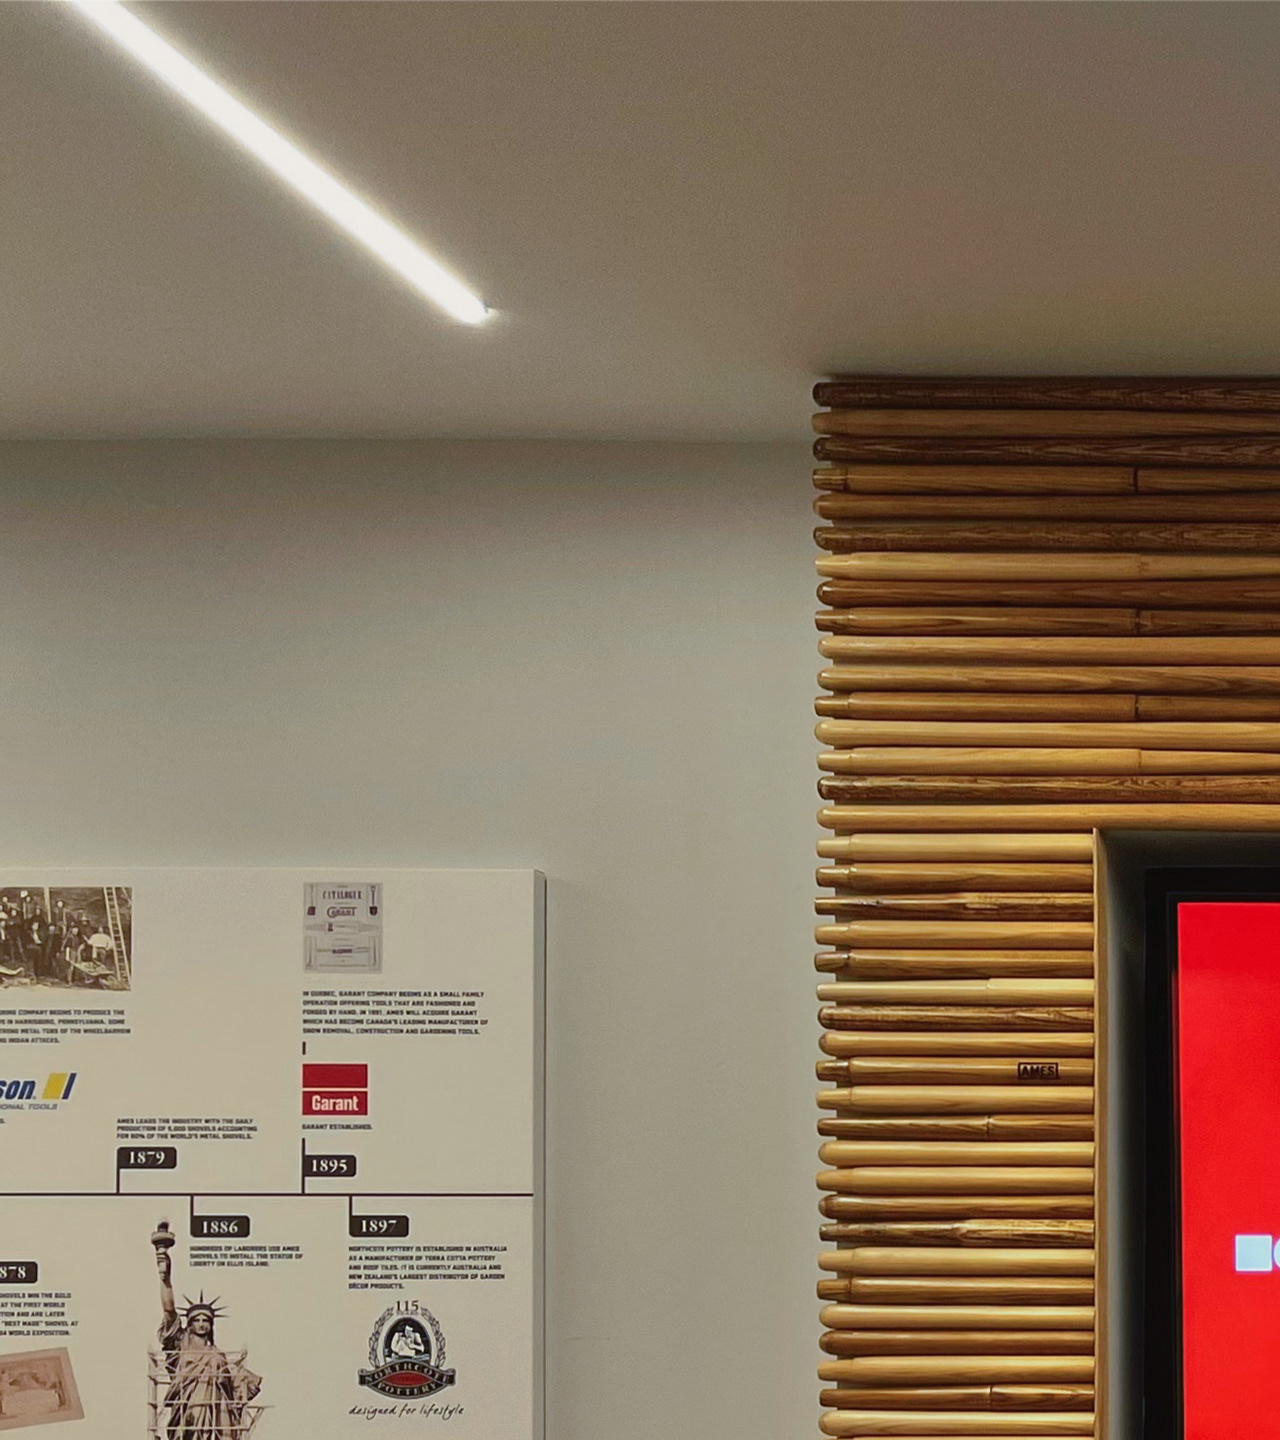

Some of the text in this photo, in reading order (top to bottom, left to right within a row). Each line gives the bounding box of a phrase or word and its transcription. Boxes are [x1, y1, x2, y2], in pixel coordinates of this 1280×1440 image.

[1021, 1064, 1056, 1077] AMES
[311, 1095, 359, 1112] Garant
[128, 1150, 165, 1165] 1879
[310, 1158, 348, 1174] 1895
[201, 1220, 239, 1235] 1886
[359, 1219, 397, 1234] 1897
[0, 1266, 26, 1279] 878
[396, 1300, 419, 1312] 115
[365, 1362, 447, 1383] NORTHCOTE
[377, 1382, 437, 1396] POTTERY
[349, 1403, 464, 1420] designed for lifestyle
